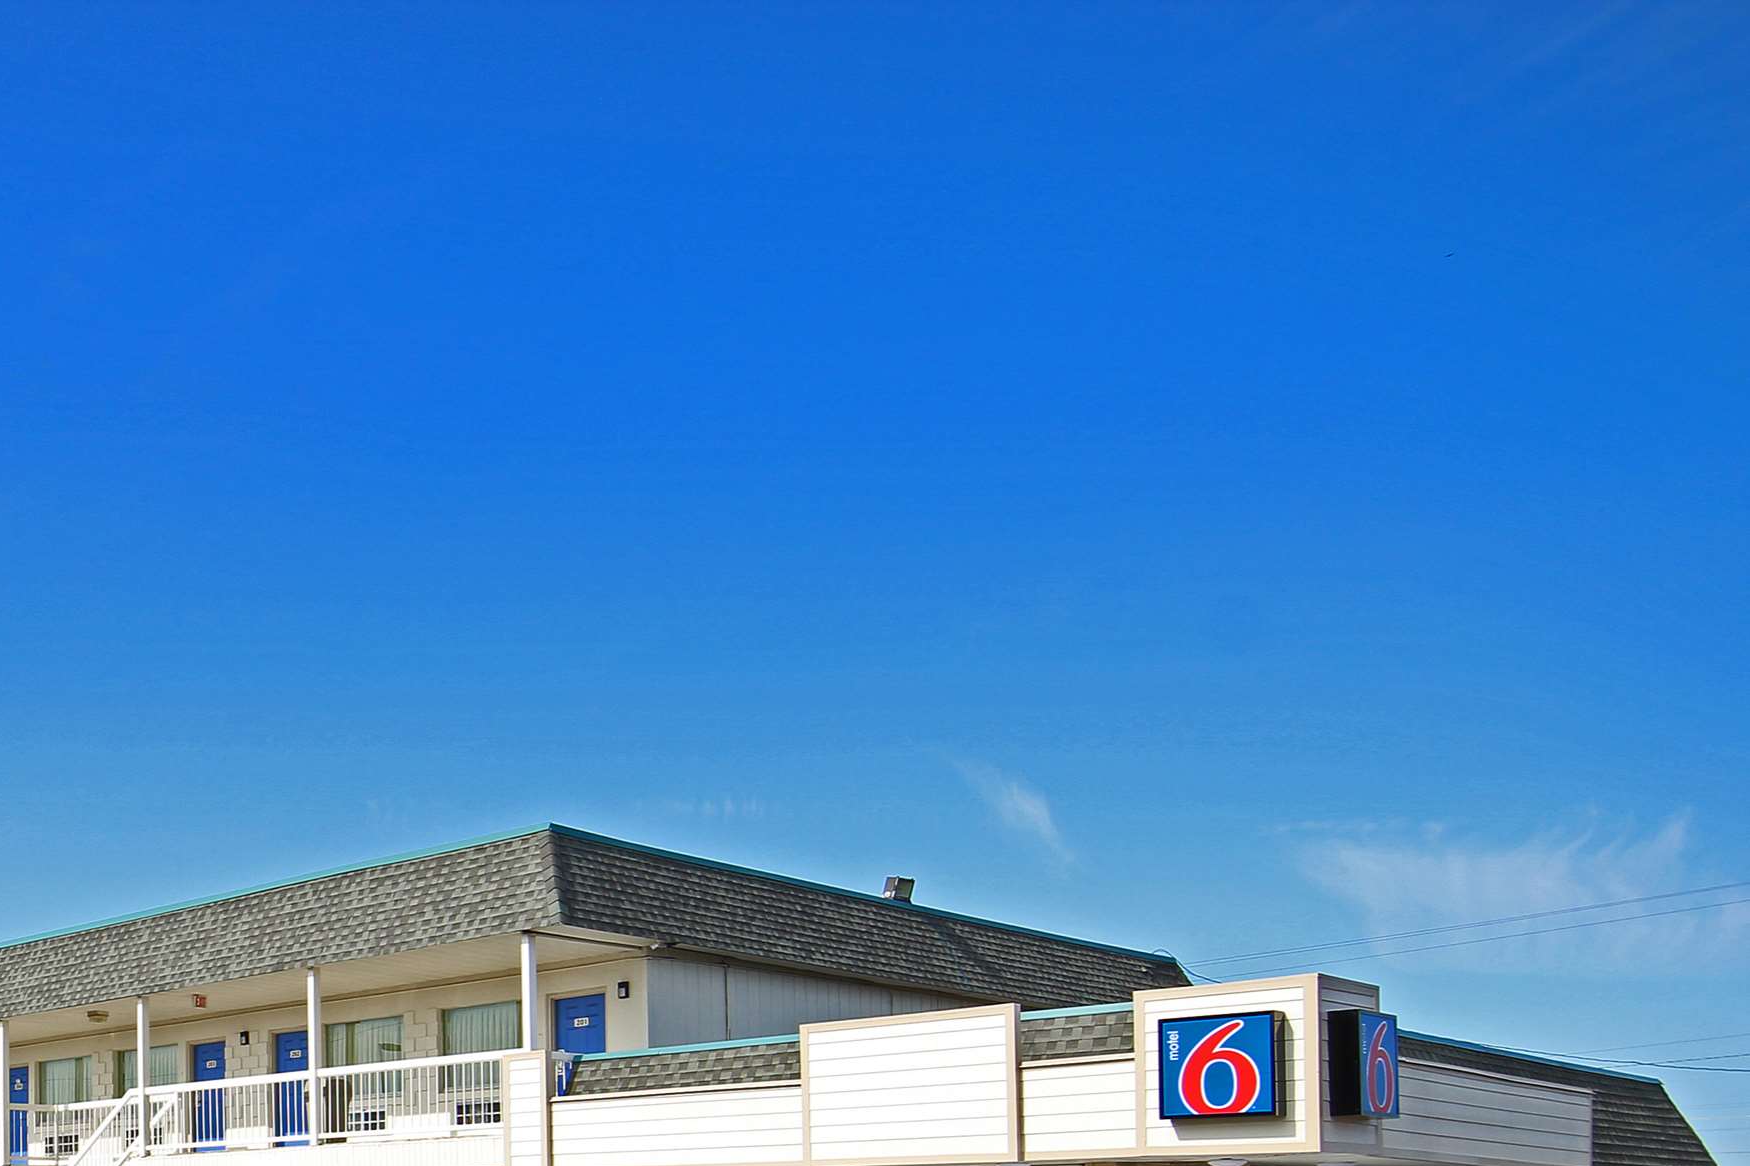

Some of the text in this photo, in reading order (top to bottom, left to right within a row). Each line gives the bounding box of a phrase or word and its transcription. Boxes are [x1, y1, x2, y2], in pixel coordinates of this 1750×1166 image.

[1167, 1029, 1179, 1061] motel
[1178, 1019, 1260, 1115] 6
[1366, 1021, 1394, 1113] 6
